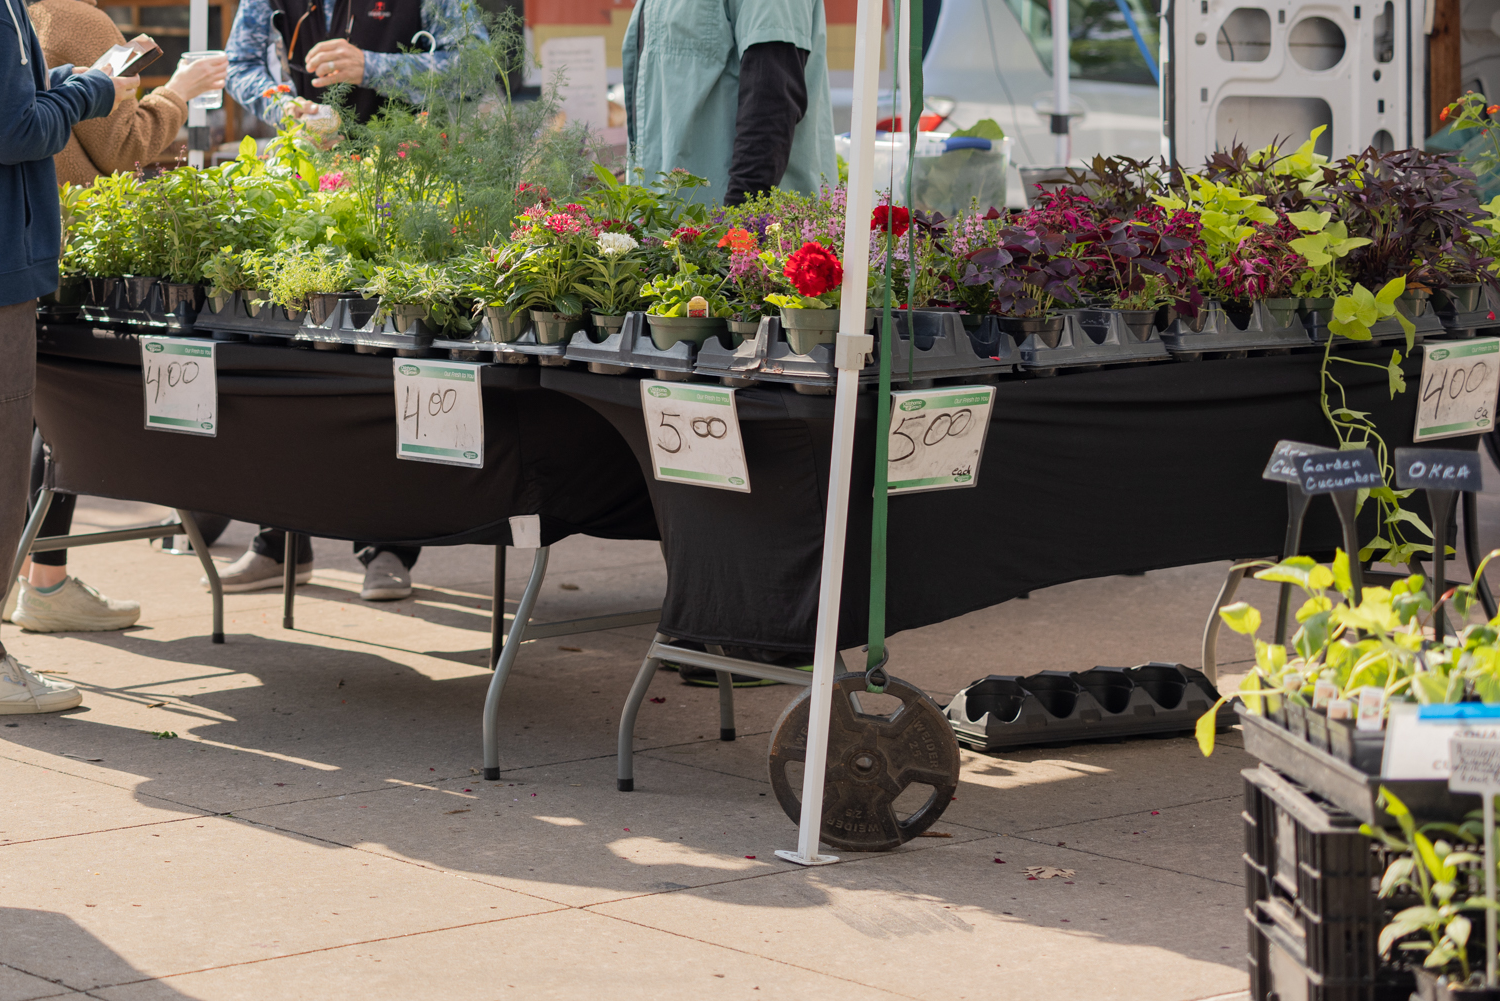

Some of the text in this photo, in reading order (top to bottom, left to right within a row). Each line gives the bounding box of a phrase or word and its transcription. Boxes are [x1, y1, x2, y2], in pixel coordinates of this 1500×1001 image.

[403, 385, 457, 440] 4.00
[657, 411, 728, 454] 5.00
[1302, 458, 1362, 473] Garden
[1408, 460, 1470, 480] OKRA
[1305, 472, 1381, 491] Cucumber
[913, 720, 939, 769] WEIDER
[845, 808, 863, 819] 25
[826, 817, 880, 833] WEIDER
